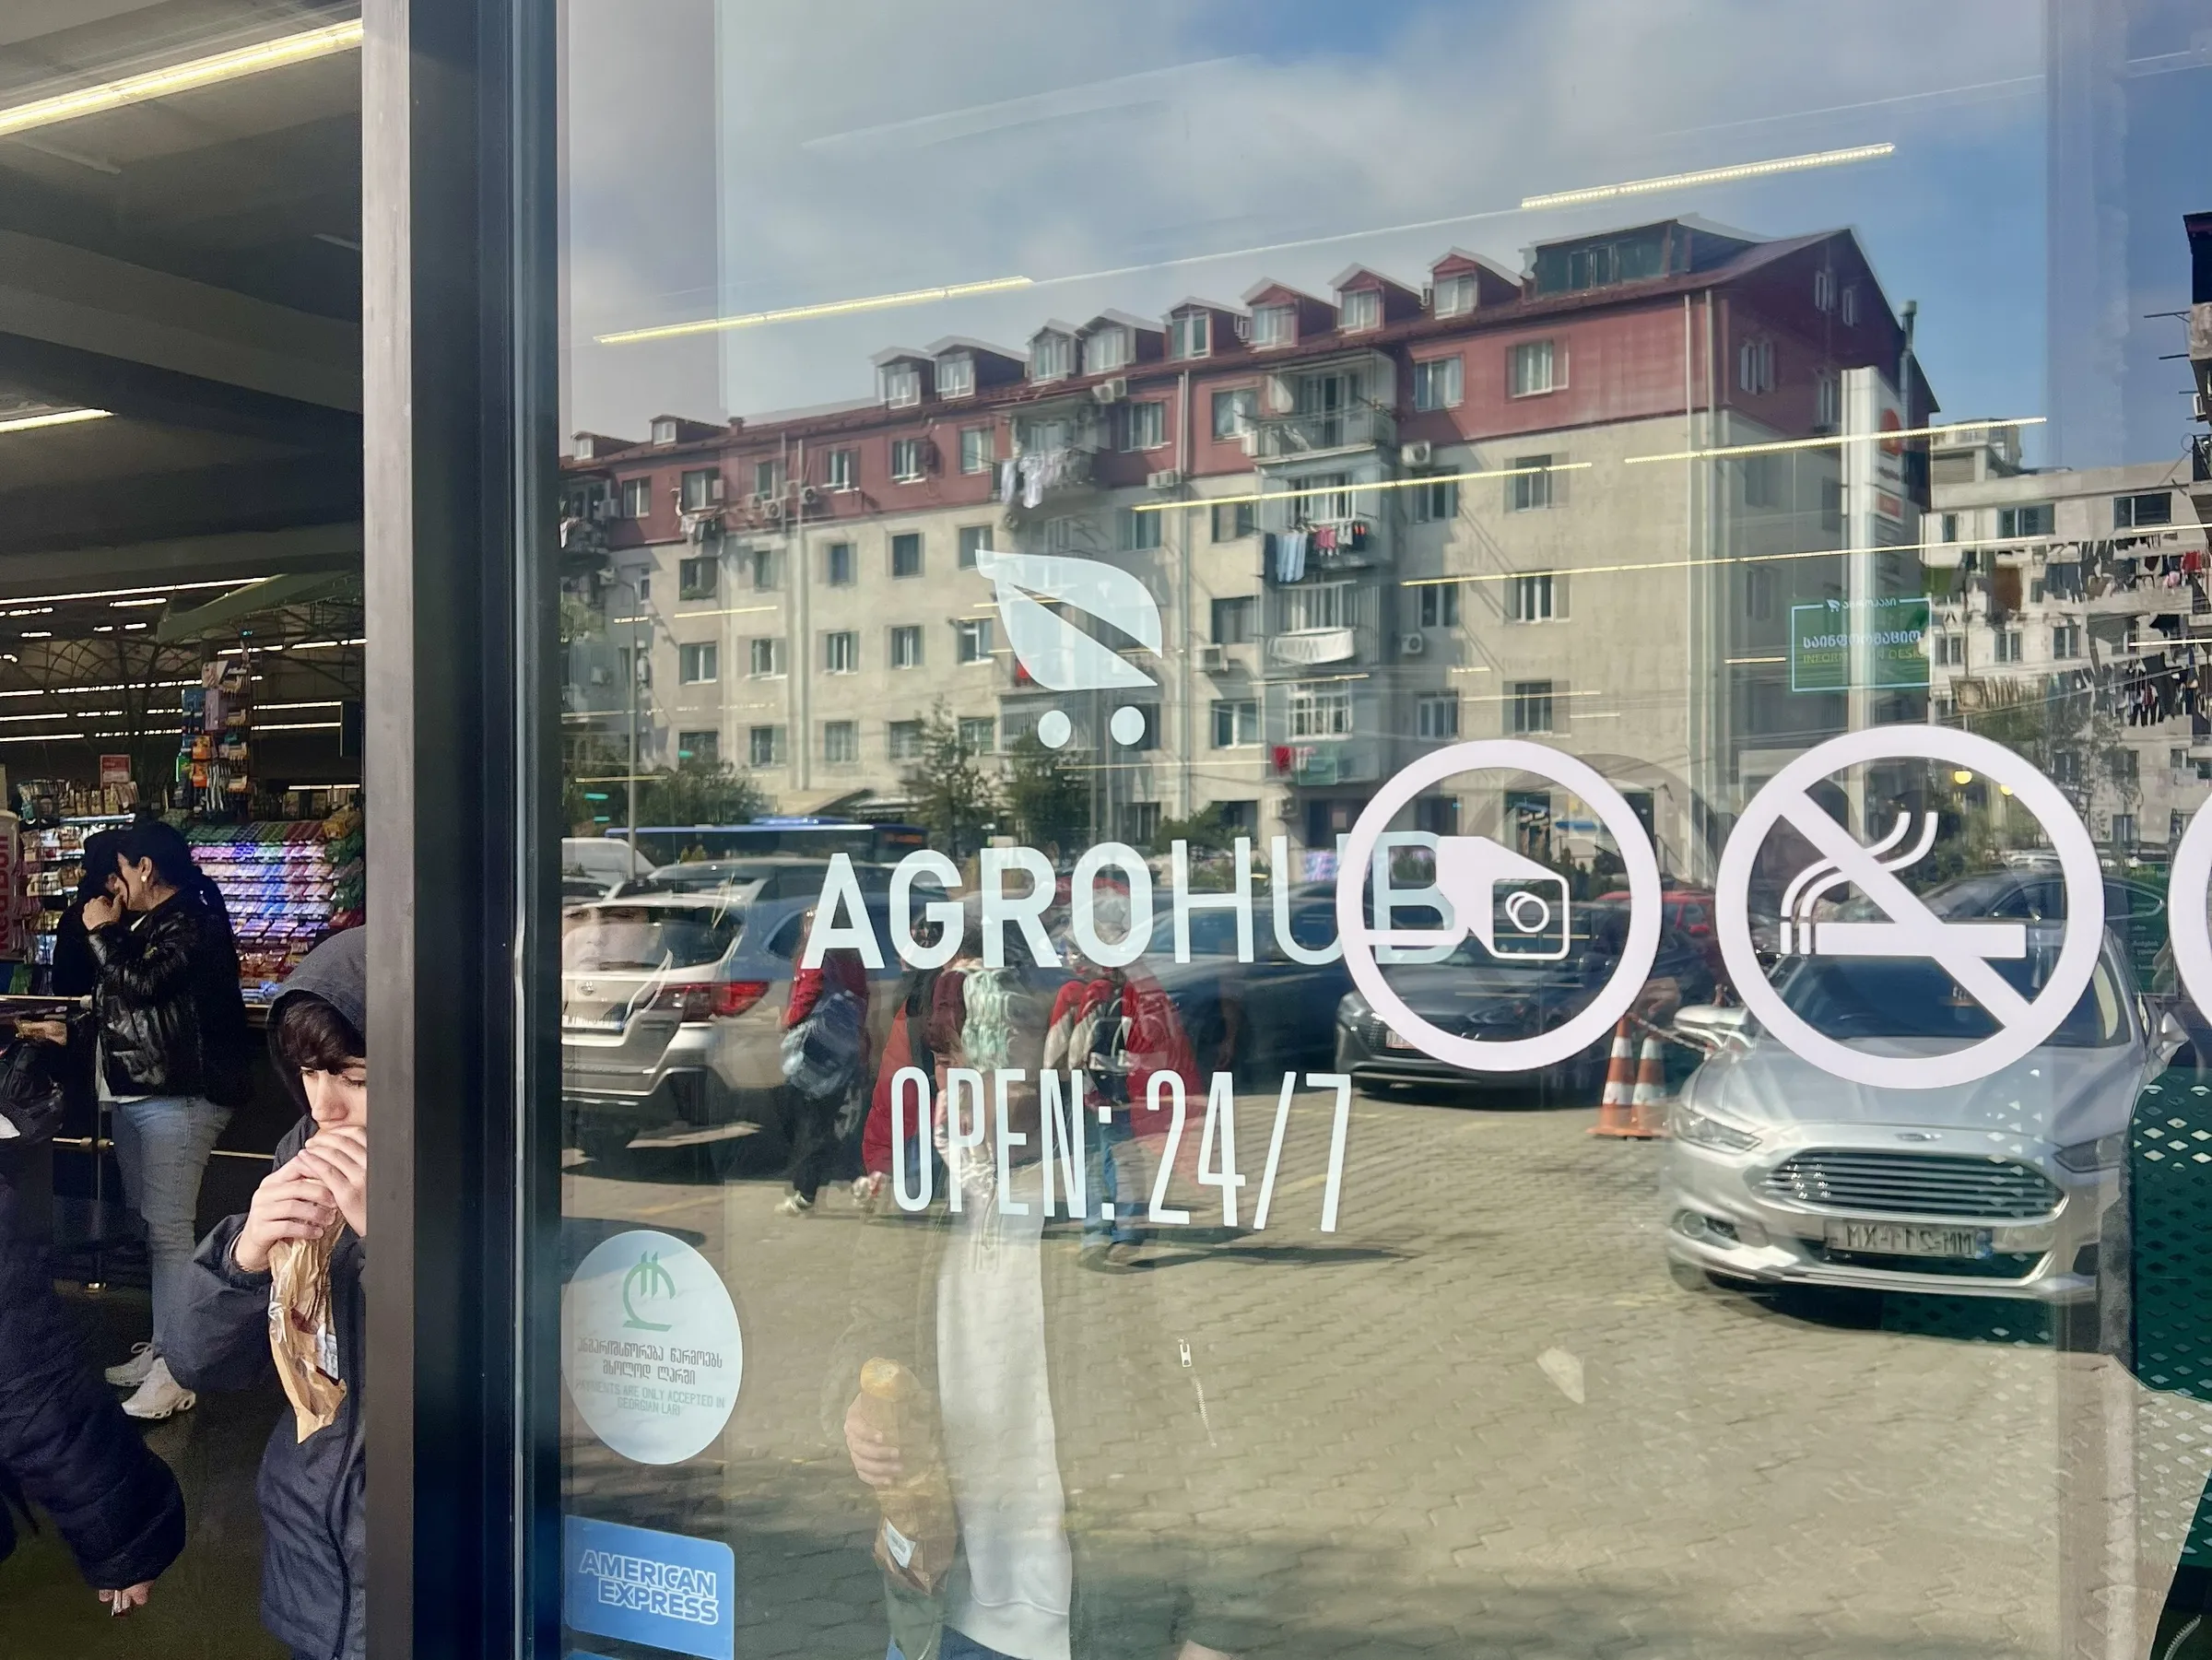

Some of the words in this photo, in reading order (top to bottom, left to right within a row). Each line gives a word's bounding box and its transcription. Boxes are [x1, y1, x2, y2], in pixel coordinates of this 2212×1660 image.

[801, 830, 1466, 969] AGROHUB
[890, 1066, 1116, 1220] OPEN:
[1147, 1070, 1352, 1233] 24/7
[603, 1360, 652, 1380] მხოლოდ
[657, 1366, 697, 1385] ლარში
[670, 1348, 724, 1369] წარმოებს
[618, 1397, 659, 1414] GEORGIAN
[661, 1403, 681, 1417] LARI
[623, 1385, 640, 1397] ARE
[641, 1386, 665, 1400] ONLY
[667, 1390, 712, 1407] ACCEPTED
[716, 1396, 726, 1408] IN
[579, 1549, 717, 1599] AMERICAN
[598, 1577, 720, 1626] EXPRESS
